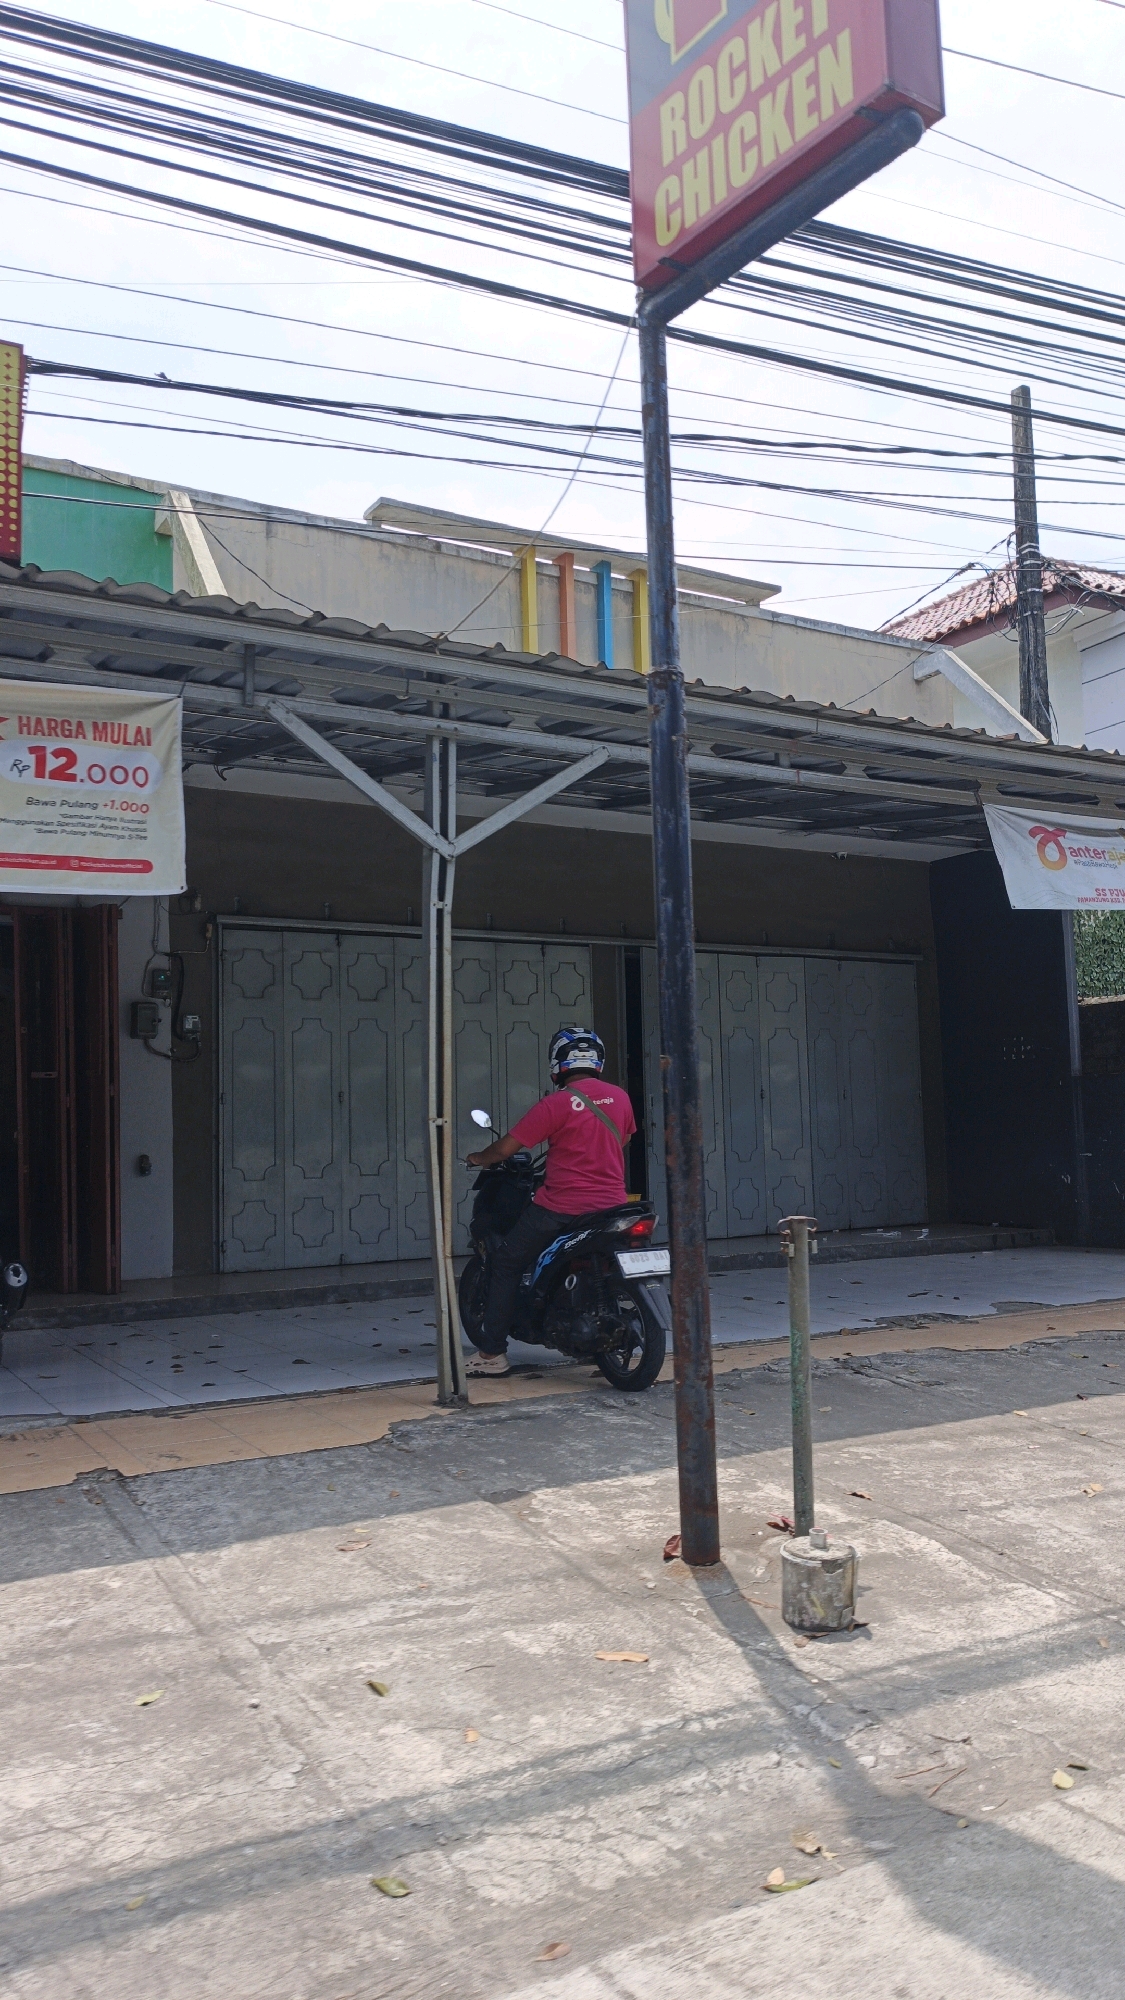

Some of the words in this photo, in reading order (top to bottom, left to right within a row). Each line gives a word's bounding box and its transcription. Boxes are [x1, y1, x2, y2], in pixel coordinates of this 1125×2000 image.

[654, 27, 854, 247] CHICKEN
[18, 715, 87, 740] HARGA
[92, 721, 153, 747] MULAI
[26, 796, 56, 807] Bawa
[59, 799, 99, 811] Pulang
[102, 799, 150, 814] +1.000
[1095, 888, 1107, 897] SS
